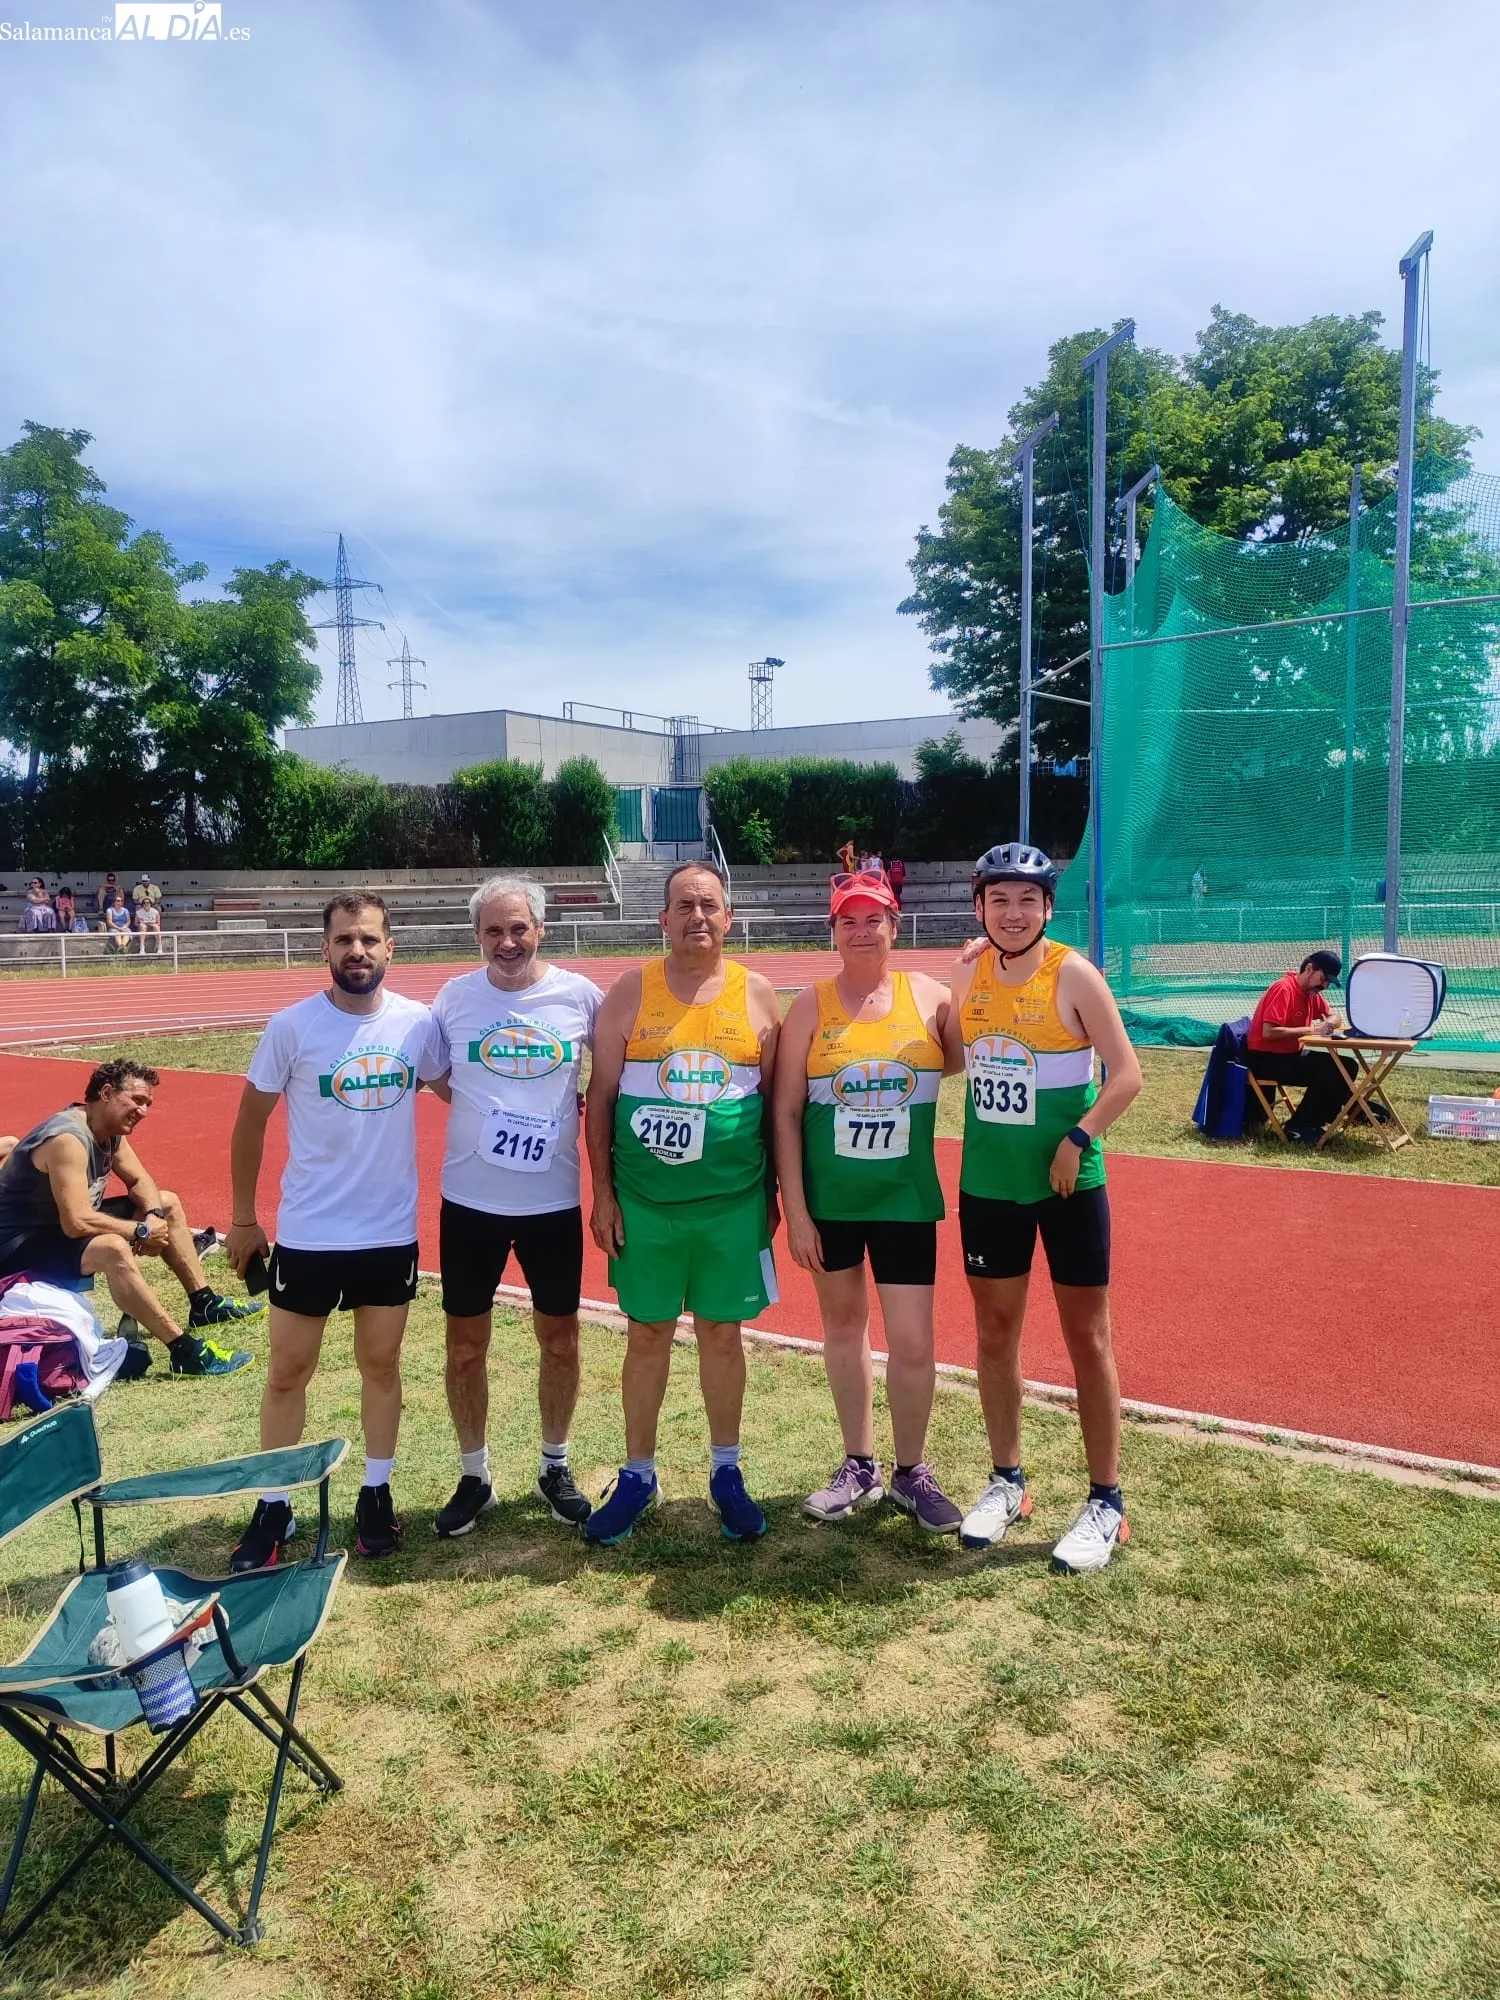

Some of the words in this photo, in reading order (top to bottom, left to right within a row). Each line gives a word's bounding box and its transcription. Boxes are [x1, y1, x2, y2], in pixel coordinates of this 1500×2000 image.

[480, 1021, 502, 1036] CLUB
[988, 1027, 1037, 1049] DEPORTIVO
[330, 1051, 353, 1069] CLUB
[358, 1045, 410, 1062] DEPORTIVO
[487, 1044, 557, 1060] ALCER
[340, 1072, 403, 1091] ALCER
[666, 1069, 725, 1087] ALCER
[841, 1078, 909, 1093] ALCER
[973, 1076, 1028, 1113] 6333
[640, 1118, 692, 1148] 2120
[848, 1121, 896, 1149] 777
[492, 1130, 546, 1161] 2115
